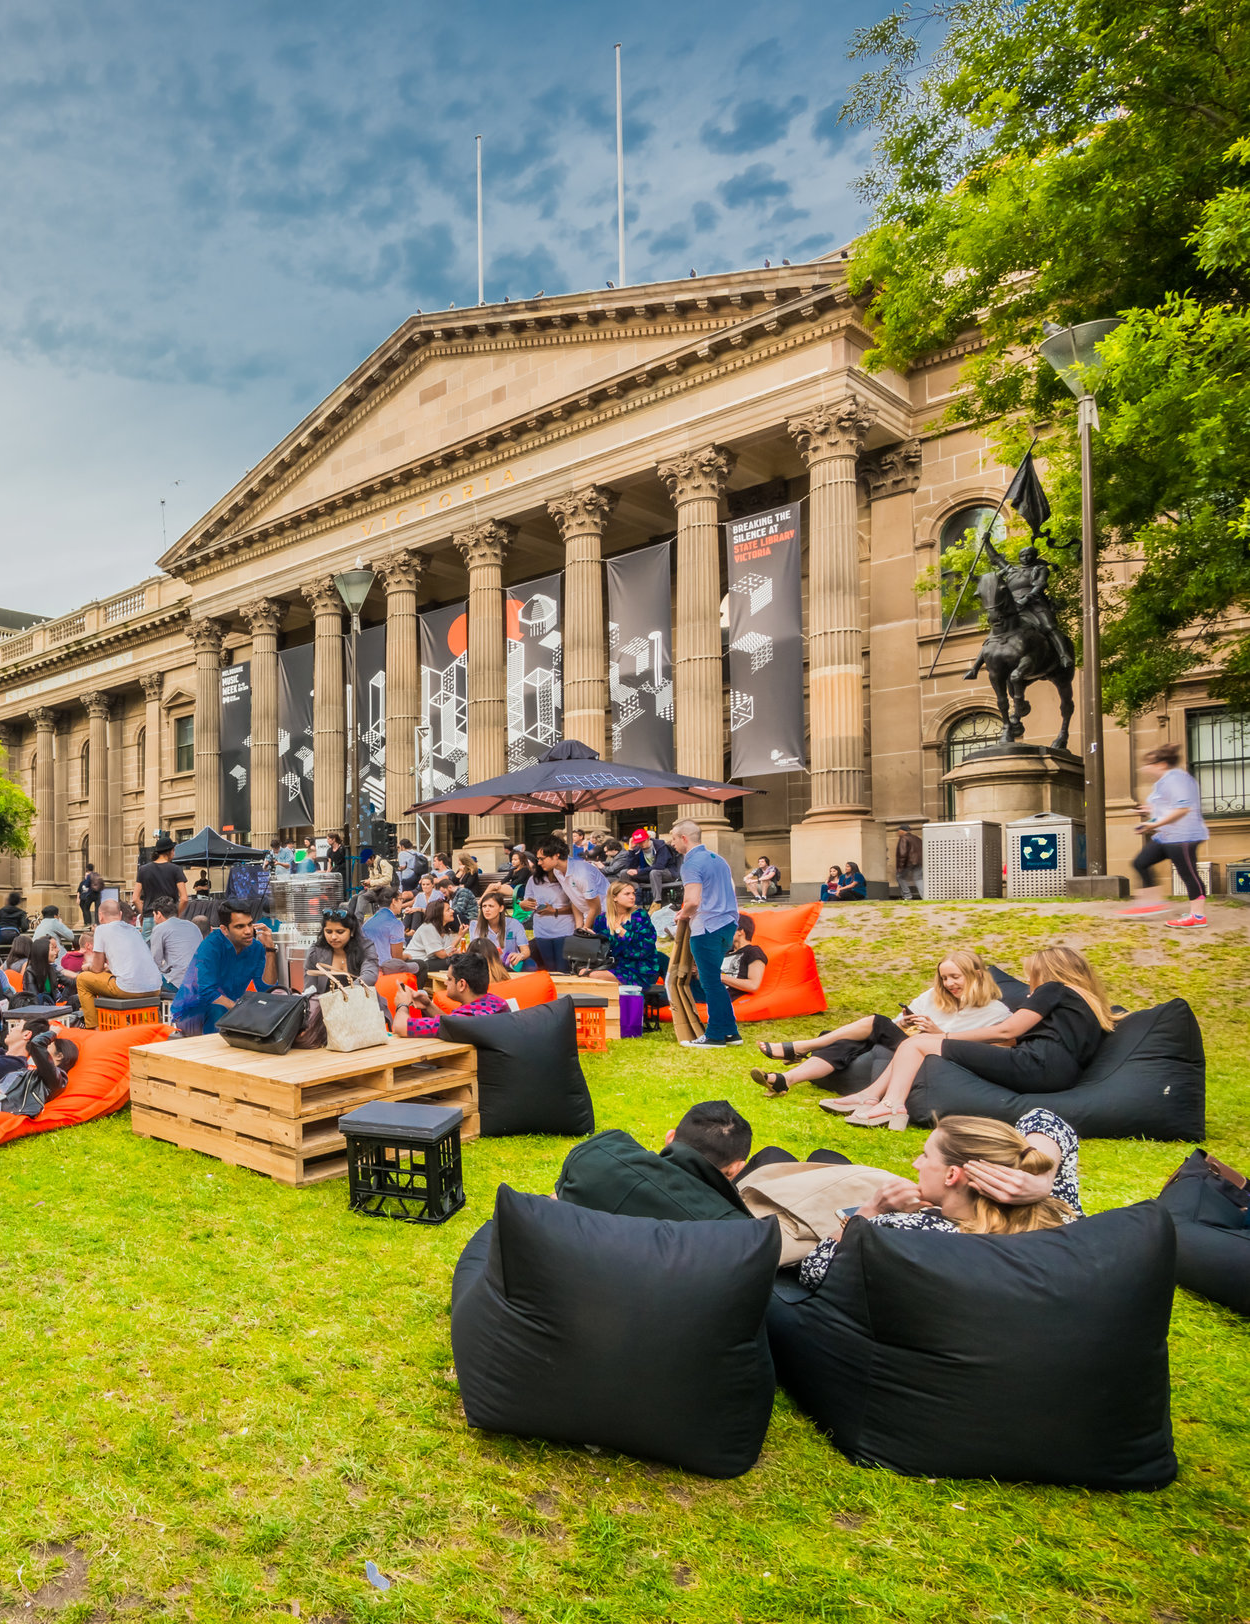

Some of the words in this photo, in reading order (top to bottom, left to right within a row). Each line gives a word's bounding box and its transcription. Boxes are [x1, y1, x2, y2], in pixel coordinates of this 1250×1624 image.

[361, 469, 516, 537] VICTORIA
[732, 515, 773, 535] BREAKING
[774, 509, 792, 523] THE
[733, 527, 767, 544] SILENCE
[768, 523, 779, 535] AT
[734, 540, 758, 554] STATE
[760, 529, 795, 547] LIBRARY
[734, 547, 772, 564] VICTORIA
